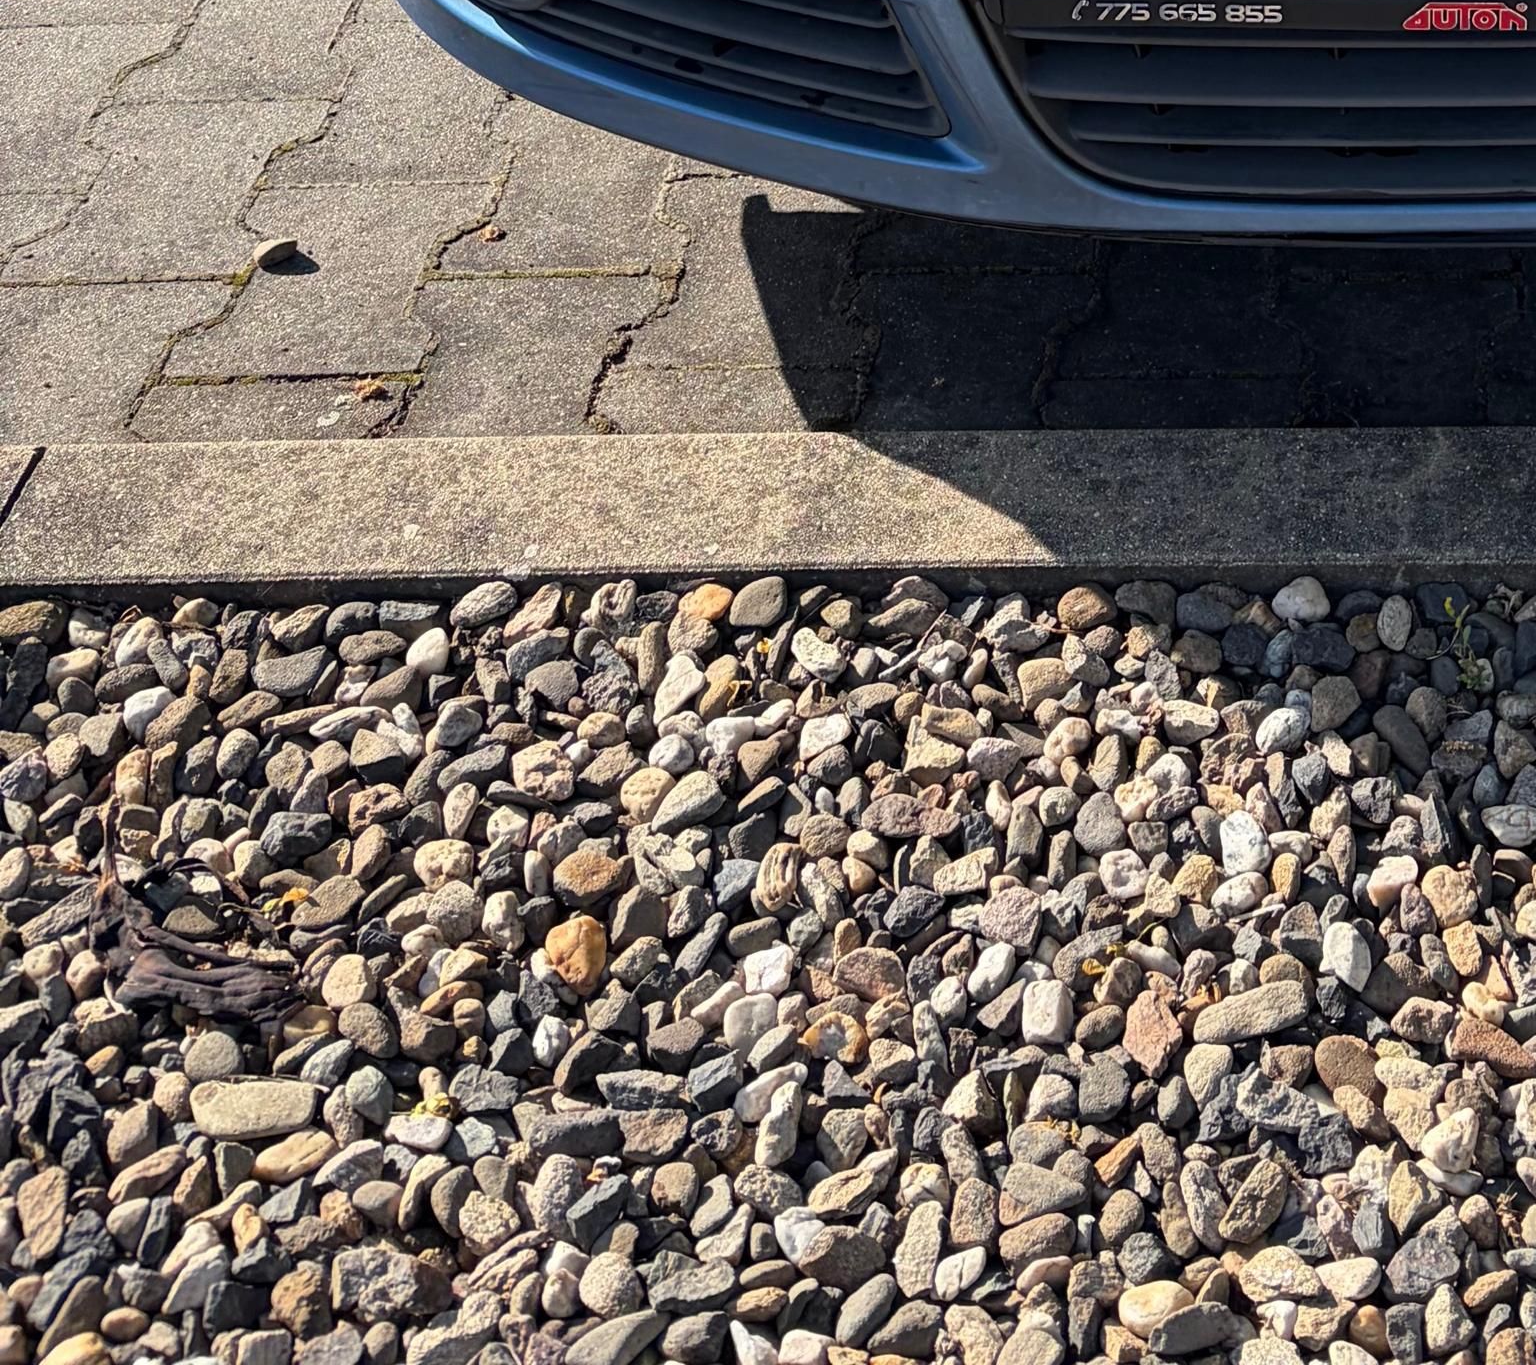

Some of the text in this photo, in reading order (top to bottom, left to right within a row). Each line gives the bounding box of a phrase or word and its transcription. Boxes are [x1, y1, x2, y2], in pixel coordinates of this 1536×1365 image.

[1095, 2, 1283, 24] 775 665 855
